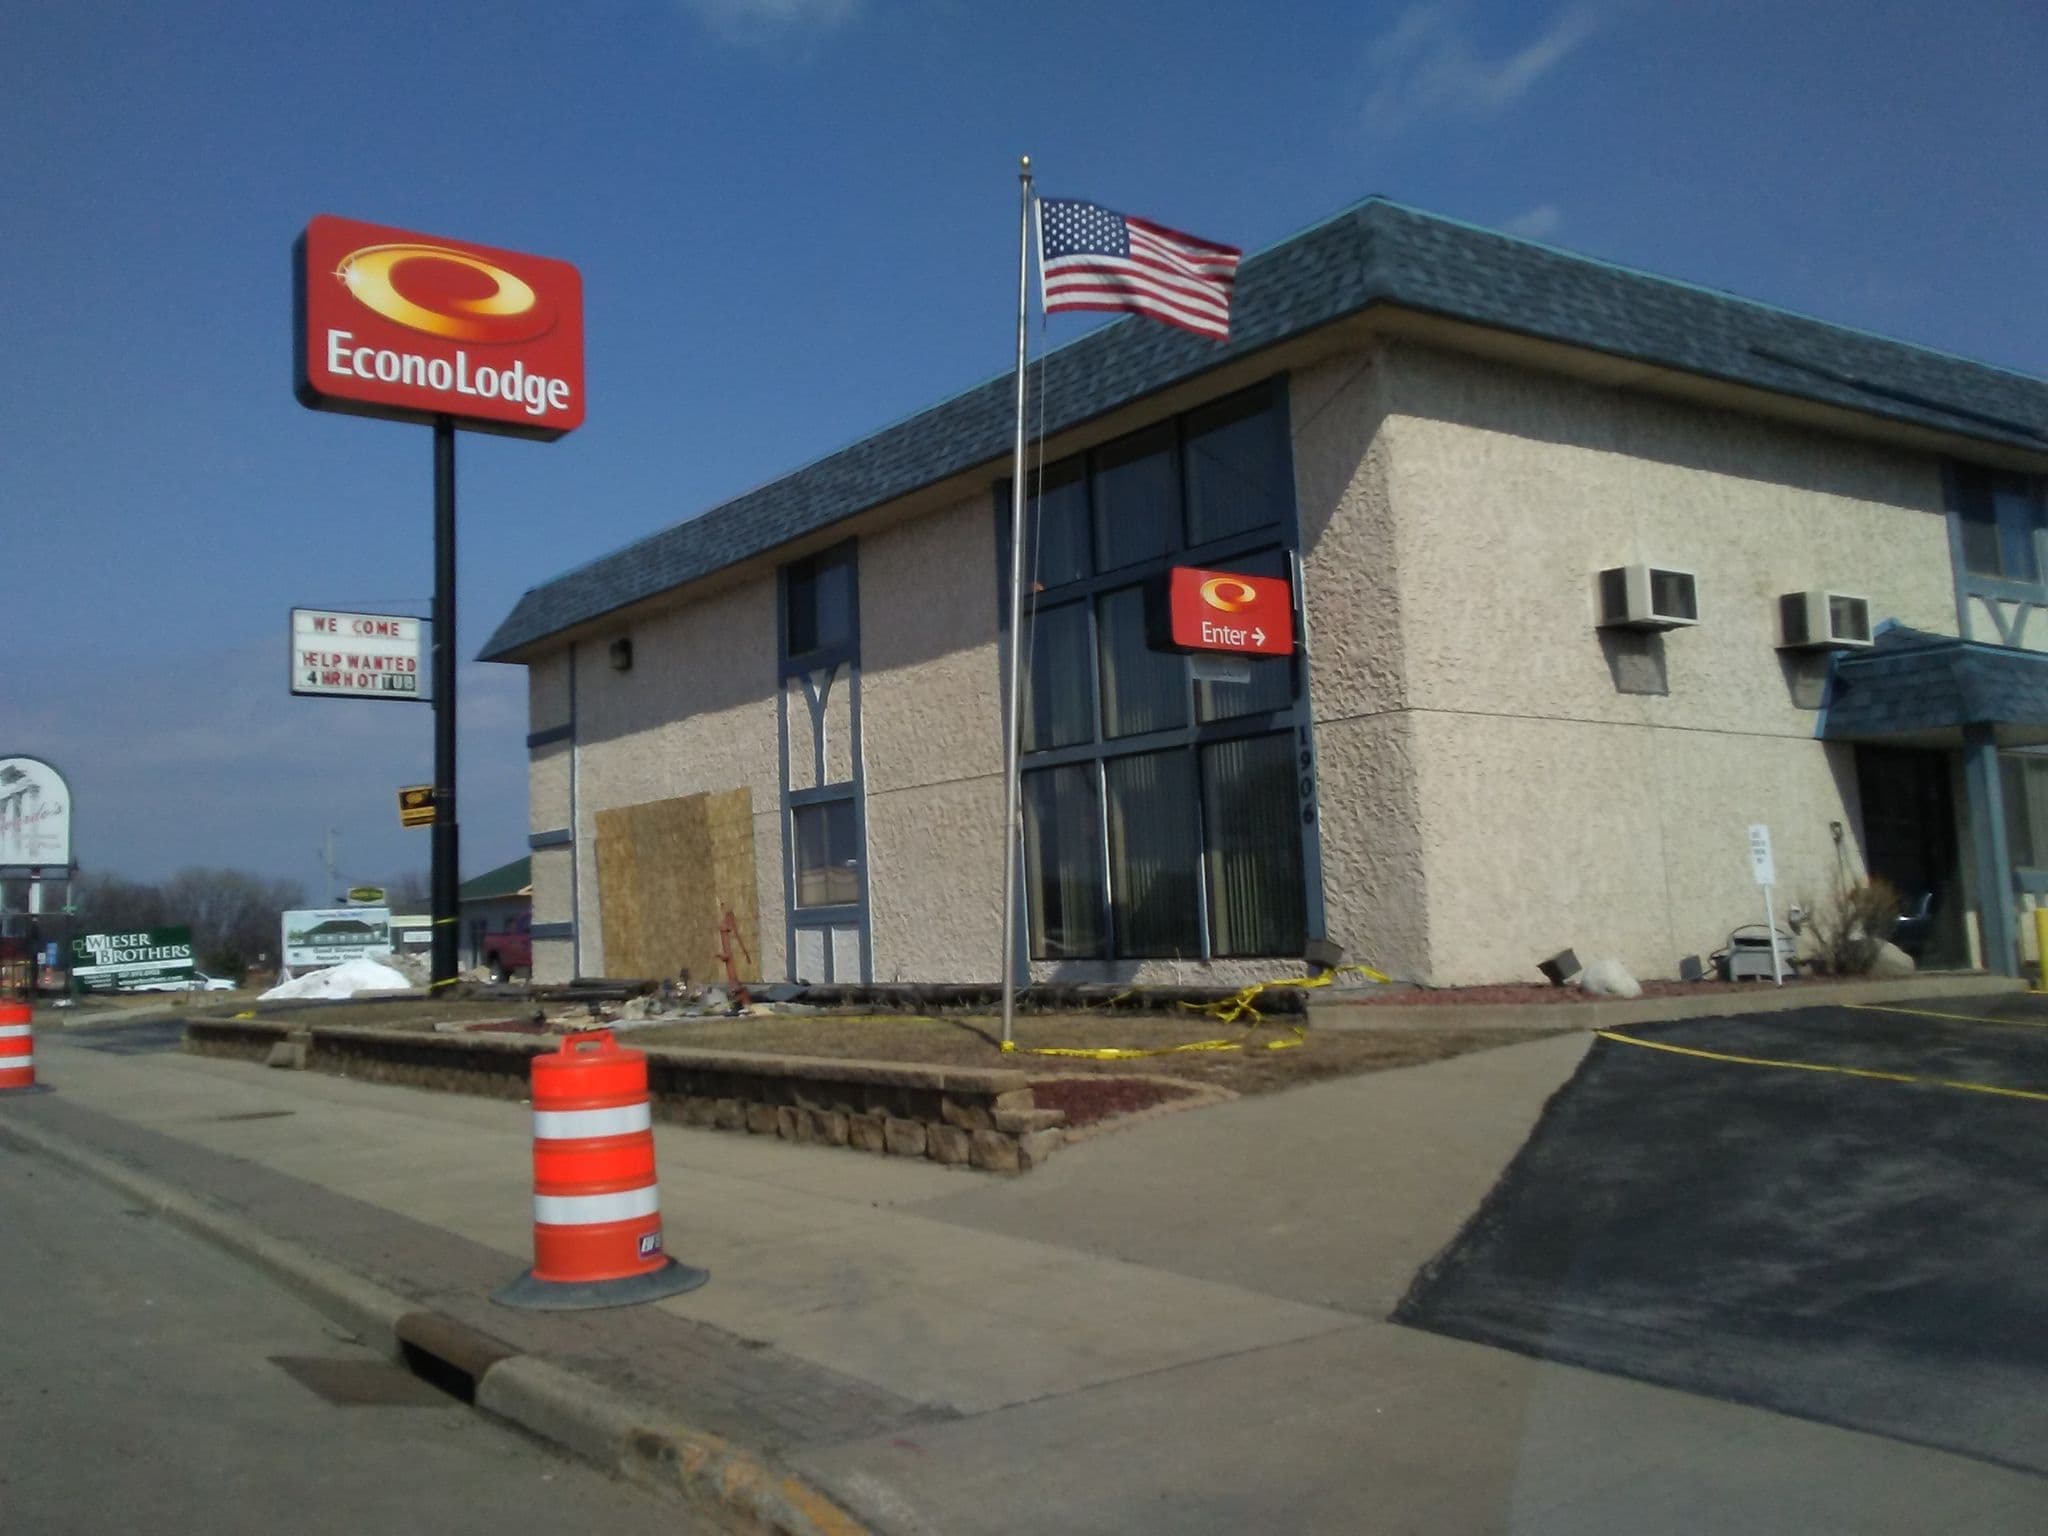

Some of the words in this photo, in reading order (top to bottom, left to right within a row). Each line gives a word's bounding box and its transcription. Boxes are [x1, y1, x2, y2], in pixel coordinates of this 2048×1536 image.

[327, 328, 570, 415] EconoLodge
[1201, 621, 1247, 645] Enter
[303, 651, 342, 668] HELP
[346, 655, 416, 672] WANTED
[1299, 724, 1315, 824] 1906
